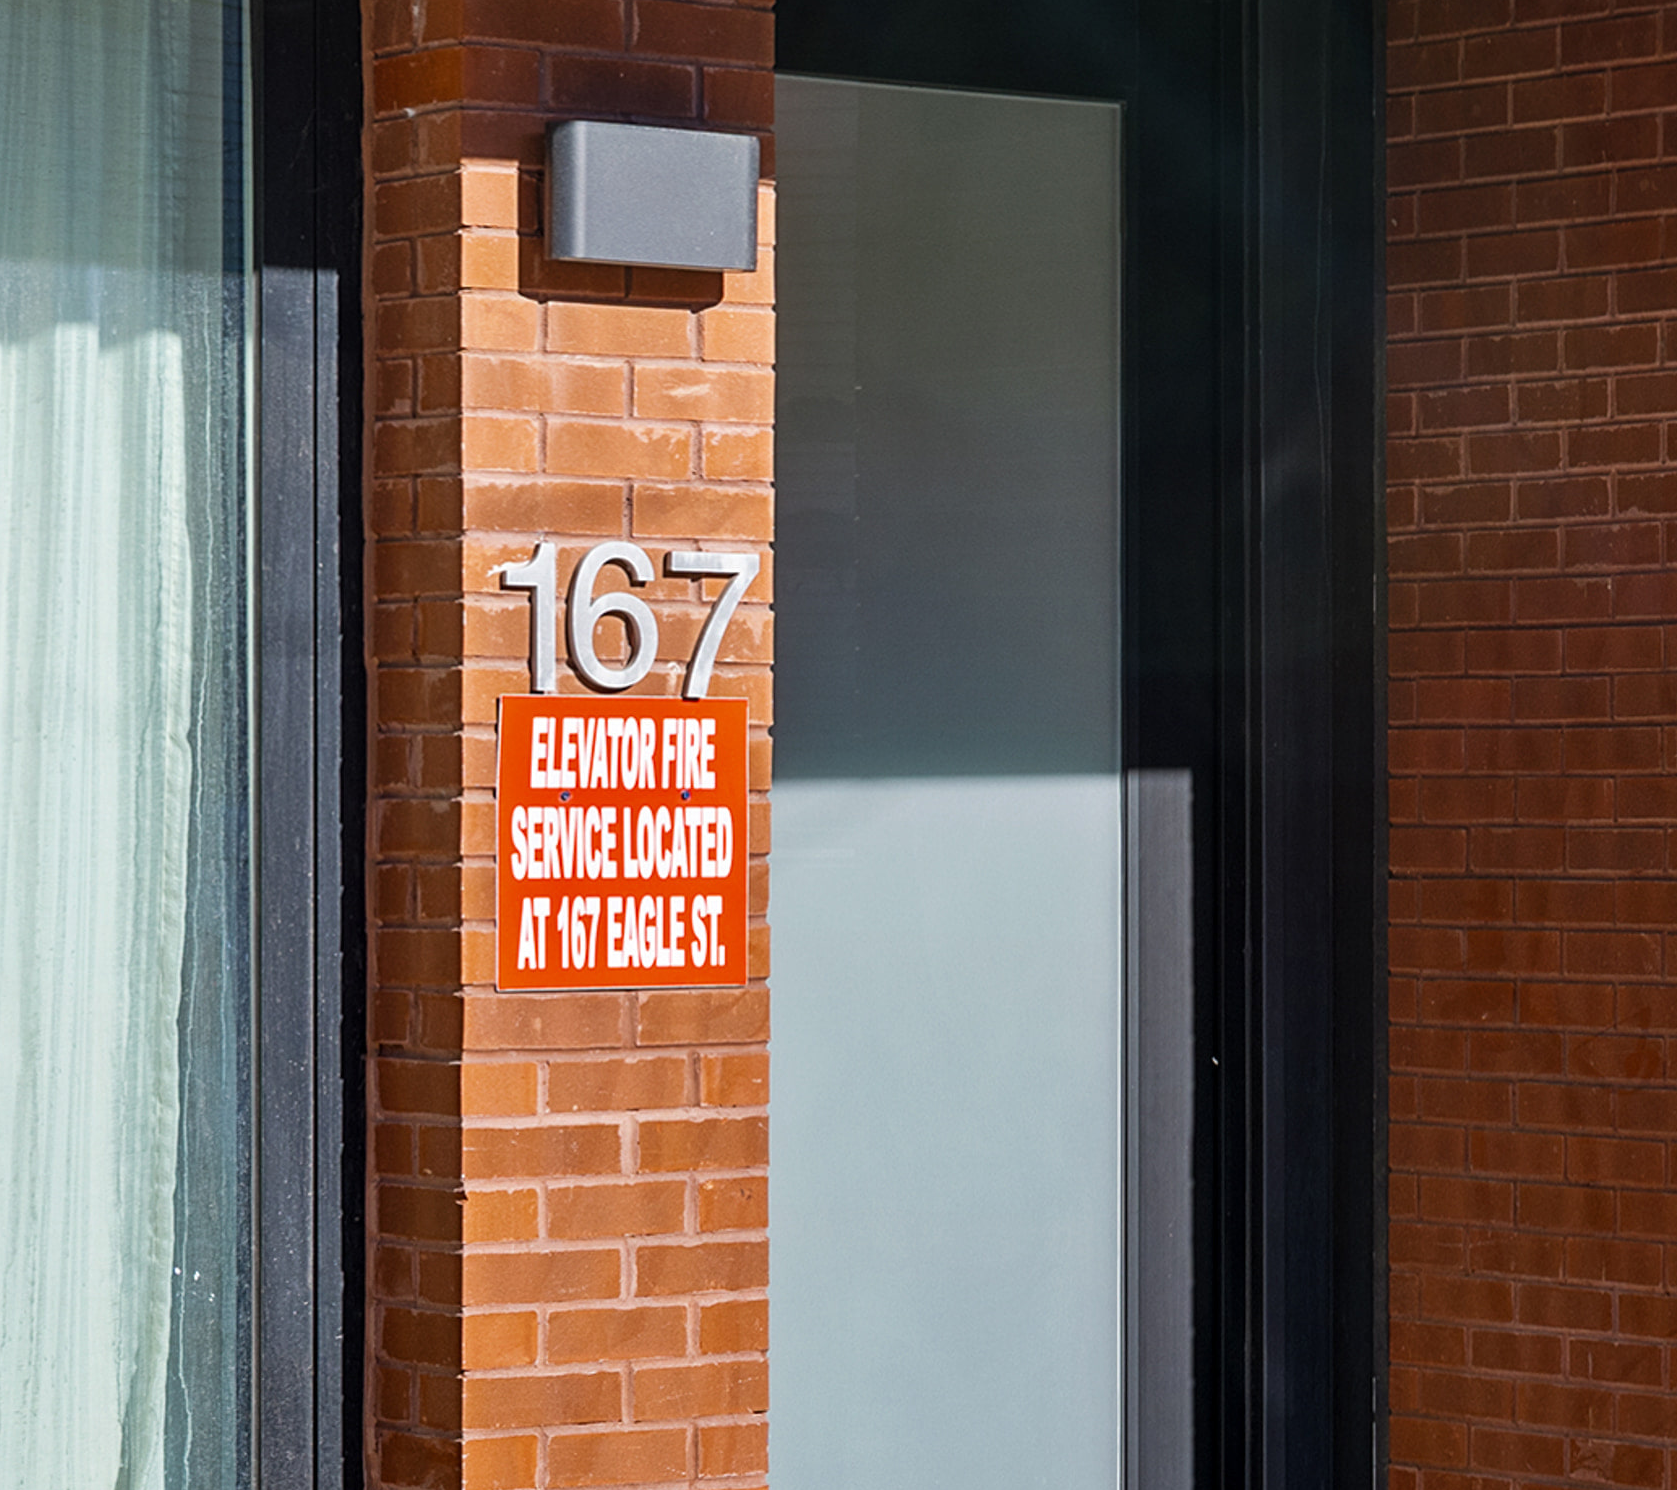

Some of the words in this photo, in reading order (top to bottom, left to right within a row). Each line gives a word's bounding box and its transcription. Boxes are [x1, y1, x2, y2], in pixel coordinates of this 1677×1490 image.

[502, 540, 760, 698] 167
[530, 717, 655, 790] ELEVATOR
[661, 717, 716, 790] FIRE
[511, 806, 617, 880] SERVICE
[623, 806, 733, 880] LOCATED
[517, 896, 550, 970] AT
[557, 896, 600, 970] 167
[607, 896, 684, 969] EAGLE
[691, 895, 725, 968] ST.
